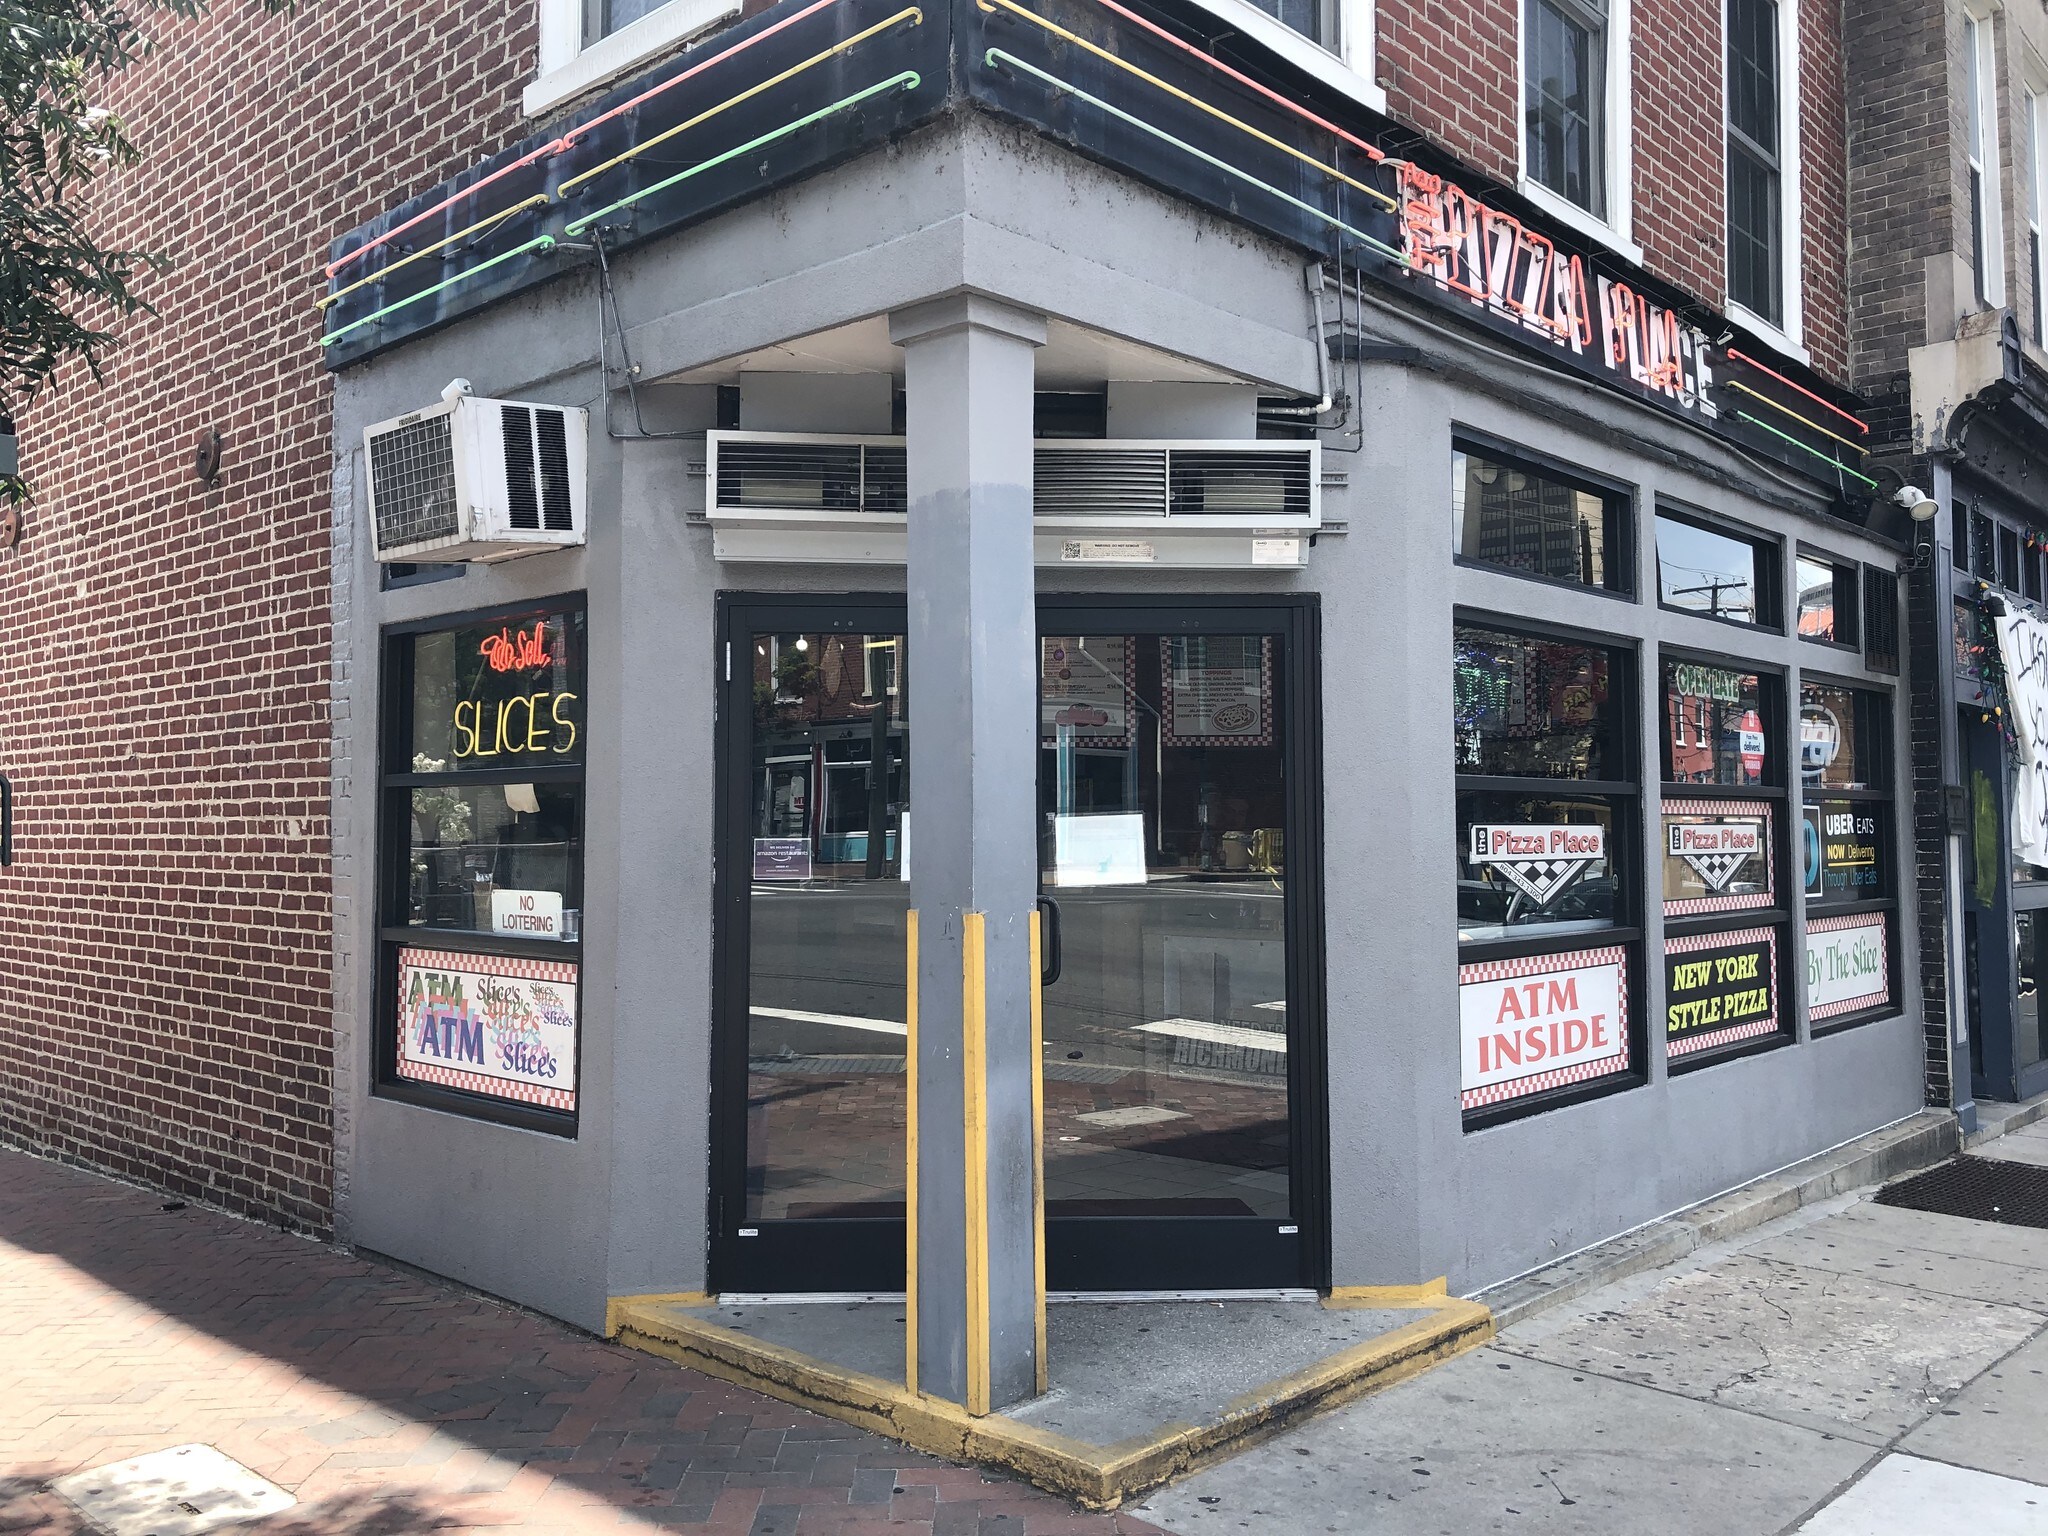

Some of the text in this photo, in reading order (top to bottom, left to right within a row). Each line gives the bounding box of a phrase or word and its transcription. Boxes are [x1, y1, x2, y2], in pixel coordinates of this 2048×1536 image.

[1435, 183, 1592, 355] PIZZA
[1598, 274, 1718, 419] PLACE
[1676, 663, 1740, 703] OPEN LATE
[453, 692, 578, 758] SLICES
[1477, 830, 1600, 855] the Pizza Place
[1682, 829, 1719, 850] Pizza
[1721, 828, 1755, 849] Place
[1826, 813, 1875, 836] UBER EATS
[1827, 843, 1875, 861] NOW Delivering
[1499, 863, 1541, 900] 804-343-1300
[1823, 866, 1877, 892] Through Uber Eats
[519, 895, 535, 912] NO
[502, 913, 554, 933] LOITERING
[1673, 953, 1759, 991] NEW YORK
[1807, 935, 1879, 1002] By The Slice
[1496, 977, 1579, 1025] ATM
[1668, 987, 1768, 1032] STYLE PIZZA
[420, 1013, 485, 1066] ATM
[1478, 1014, 1609, 1073] INSIDE
[502, 1041, 557, 1079] Slice's
